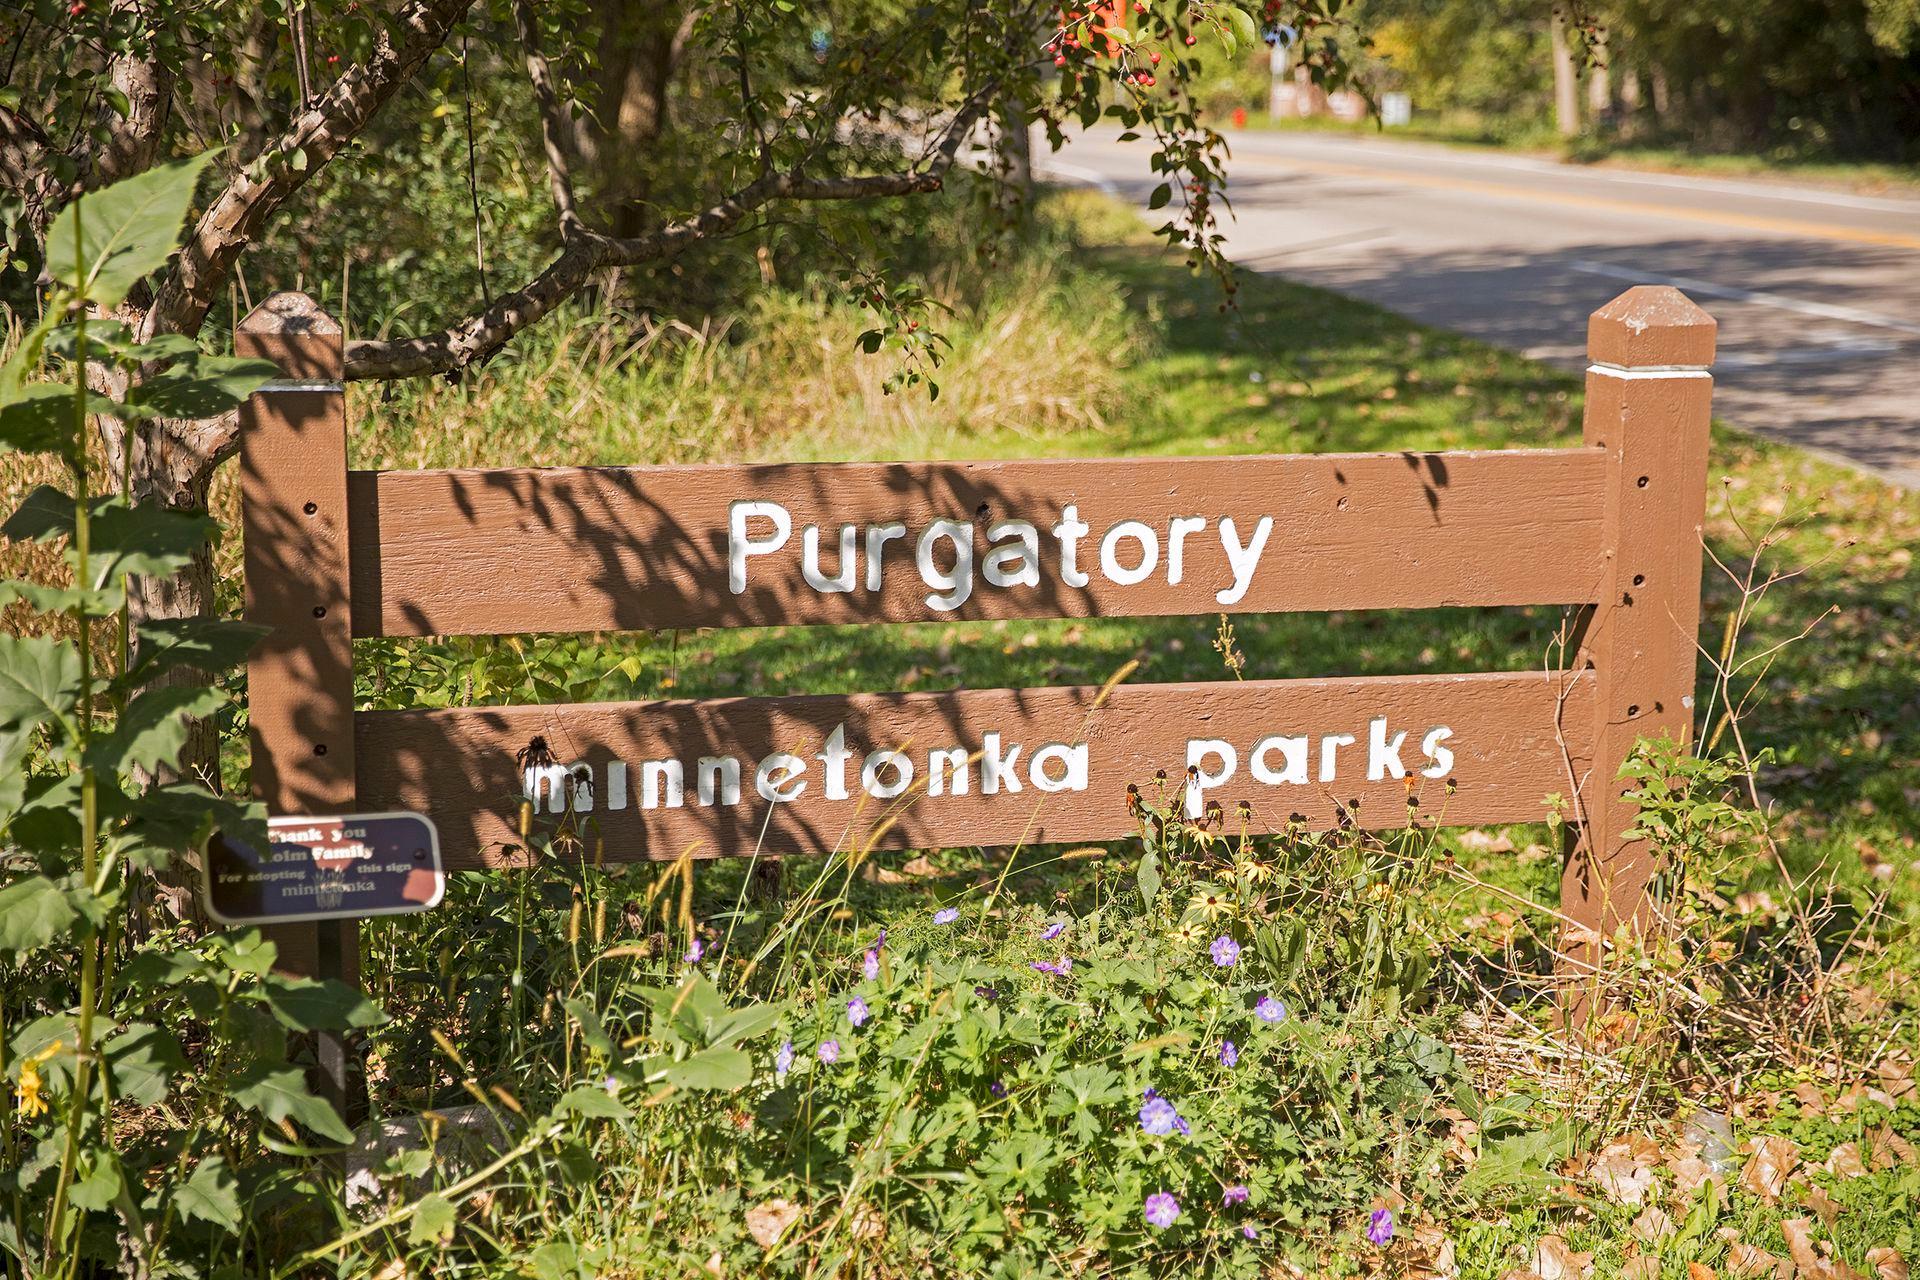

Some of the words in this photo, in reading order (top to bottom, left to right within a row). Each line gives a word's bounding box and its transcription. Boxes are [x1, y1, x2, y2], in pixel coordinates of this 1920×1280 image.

[728, 500, 1274, 612] Purgatory
[522, 722, 1089, 815] minnetonka
[1185, 714, 1455, 820] parks
[331, 826, 367, 843] you
[312, 843, 375, 862] Family
[218, 873, 243, 884] For
[247, 870, 307, 882] adopting
[357, 863, 382, 874] this
[385, 861, 412, 874] sign
